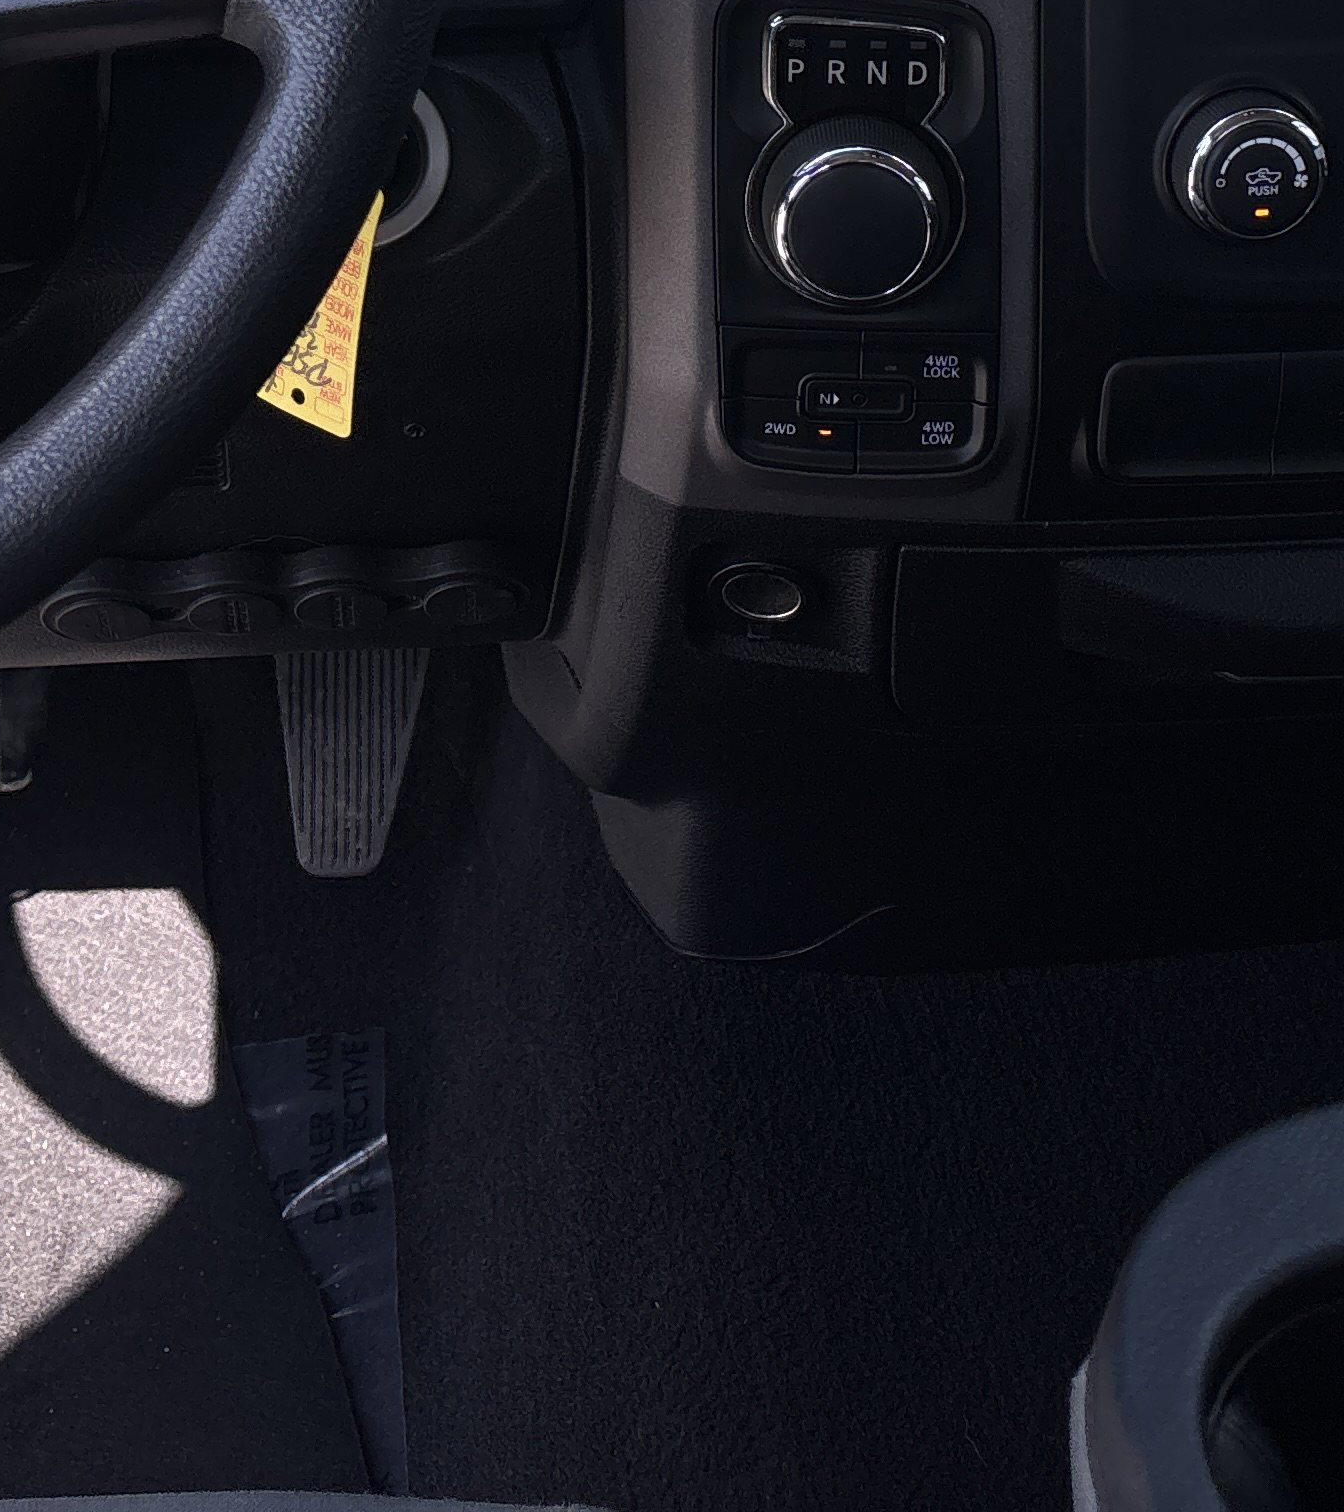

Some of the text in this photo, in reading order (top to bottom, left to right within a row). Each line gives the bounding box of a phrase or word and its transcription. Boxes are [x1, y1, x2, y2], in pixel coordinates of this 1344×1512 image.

[787, 58, 928, 86] P R N D
[1247, 185, 1279, 197] PUSH
[325, 319, 352, 342] MAKE
[924, 355, 959, 368] 4WD
[923, 366, 961, 379] LOCK
[819, 394, 831, 405] N
[764, 423, 797, 435] 2WD
[922, 421, 955, 433] 4WD
[921, 433, 955, 445] LOW
